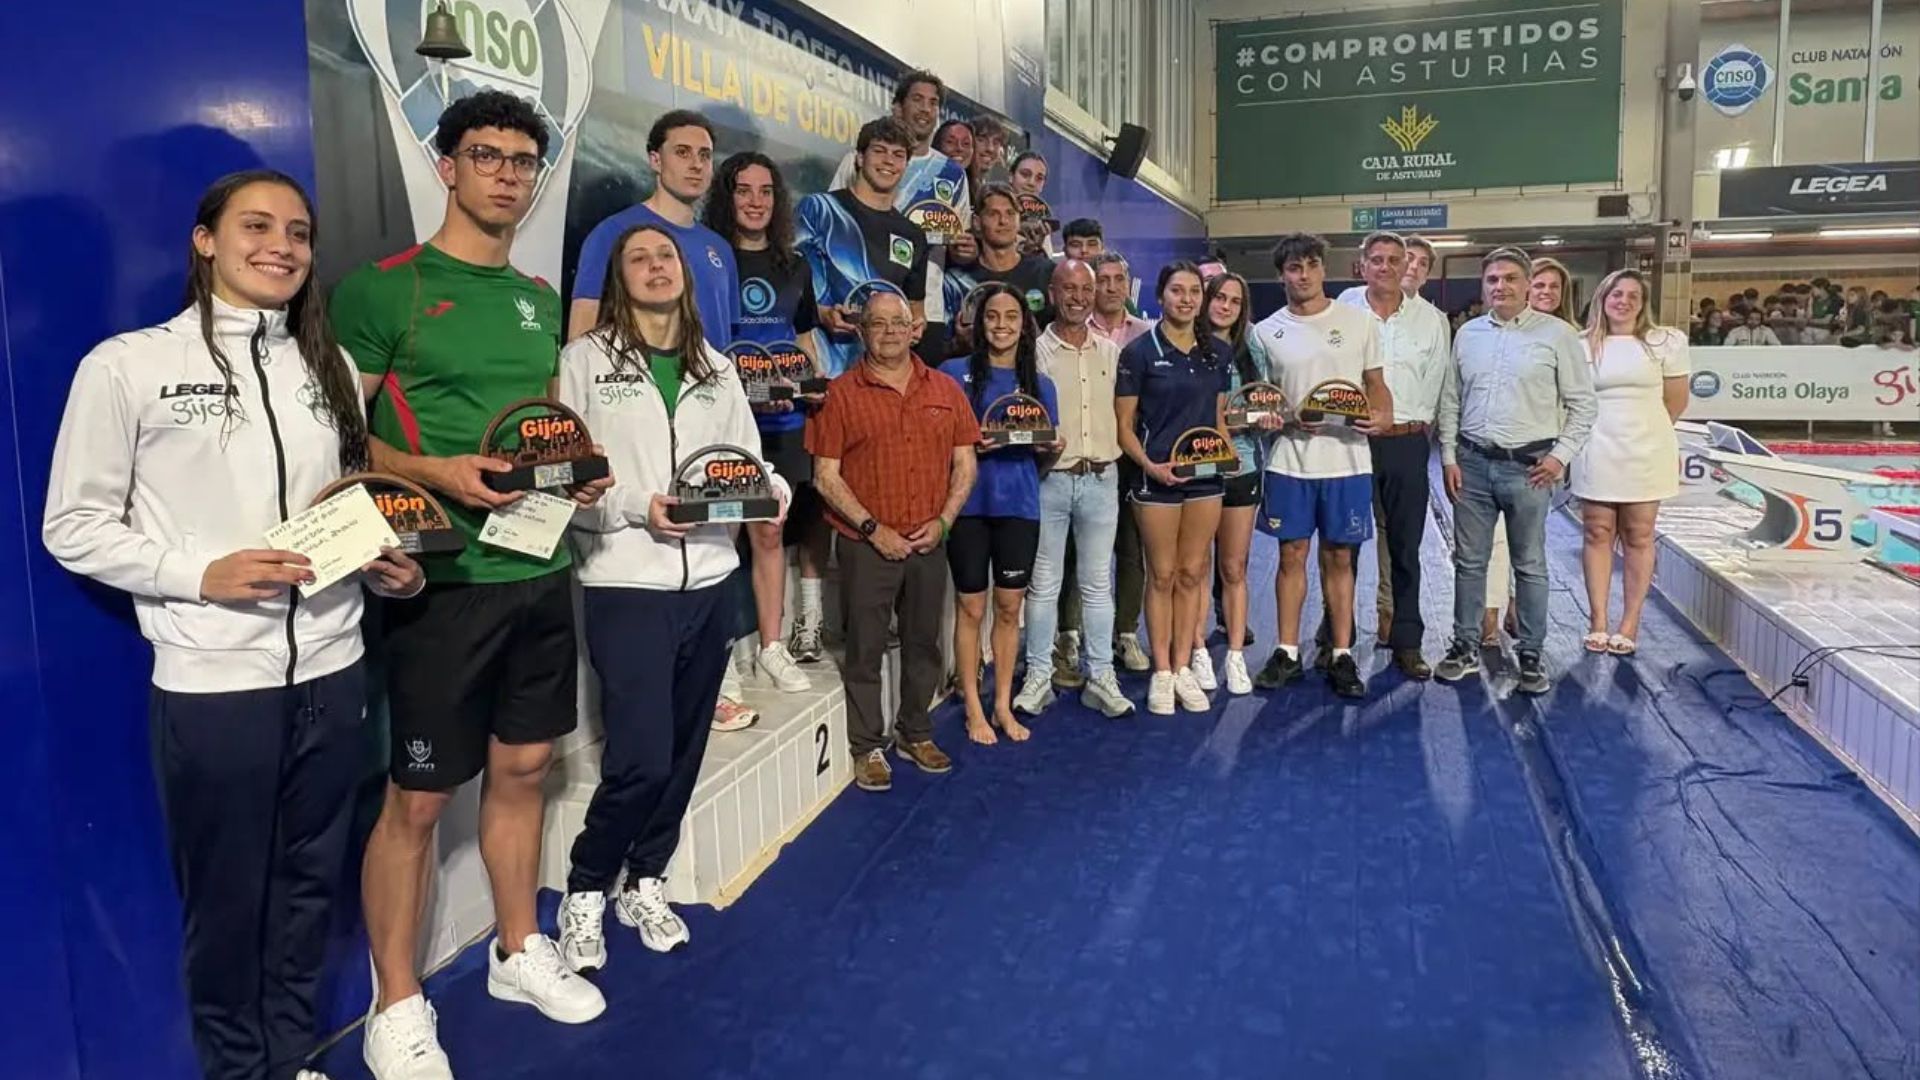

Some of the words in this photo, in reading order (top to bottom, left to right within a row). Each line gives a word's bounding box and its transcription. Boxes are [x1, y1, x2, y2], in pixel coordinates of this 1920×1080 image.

[428, 0, 538, 77] nso
[1236, 17, 1600, 67] #COMPROMETIDOS
[1791, 51, 1828, 64] CLUB
[642, 23, 744, 108] VILLA
[752, 73, 789, 123] DE
[1237, 69, 1322, 95] CON
[1357, 47, 1599, 86] ASTURIAS
[1716, 69, 1754, 84] cnso
[1788, 72, 1903, 106] Sana
[1361, 155, 1400, 170] CAJA
[1402, 153, 1457, 168] RURAL
[1376, 172, 1390, 181] DE
[1392, 169, 1442, 180] ASTURIAS
[1789, 173, 1888, 195] LEGEA
[924, 209, 956, 225] Gijón
[738, 354, 773, 370] Gijón
[594, 373, 645, 385] LEGEA
[1873, 366, 1920, 406] gi
[159, 383, 241, 399] LEGEA
[1250, 391, 1281, 404] Gijón
[1330, 389, 1363, 402] Gijón
[1732, 382, 1787, 399] Santa
[1795, 382, 1849, 403] Olaya
[1006, 404, 1041, 418] Gijón
[520, 417, 576, 440] Gijón
[1192, 438, 1223, 451] Gijón
[707, 461, 758, 480] Gijón
[1684, 455, 1705, 479] 6
[374, 493, 425, 517] ijón
[1813, 508, 1843, 542] 5
[815, 722, 831, 777] 2
